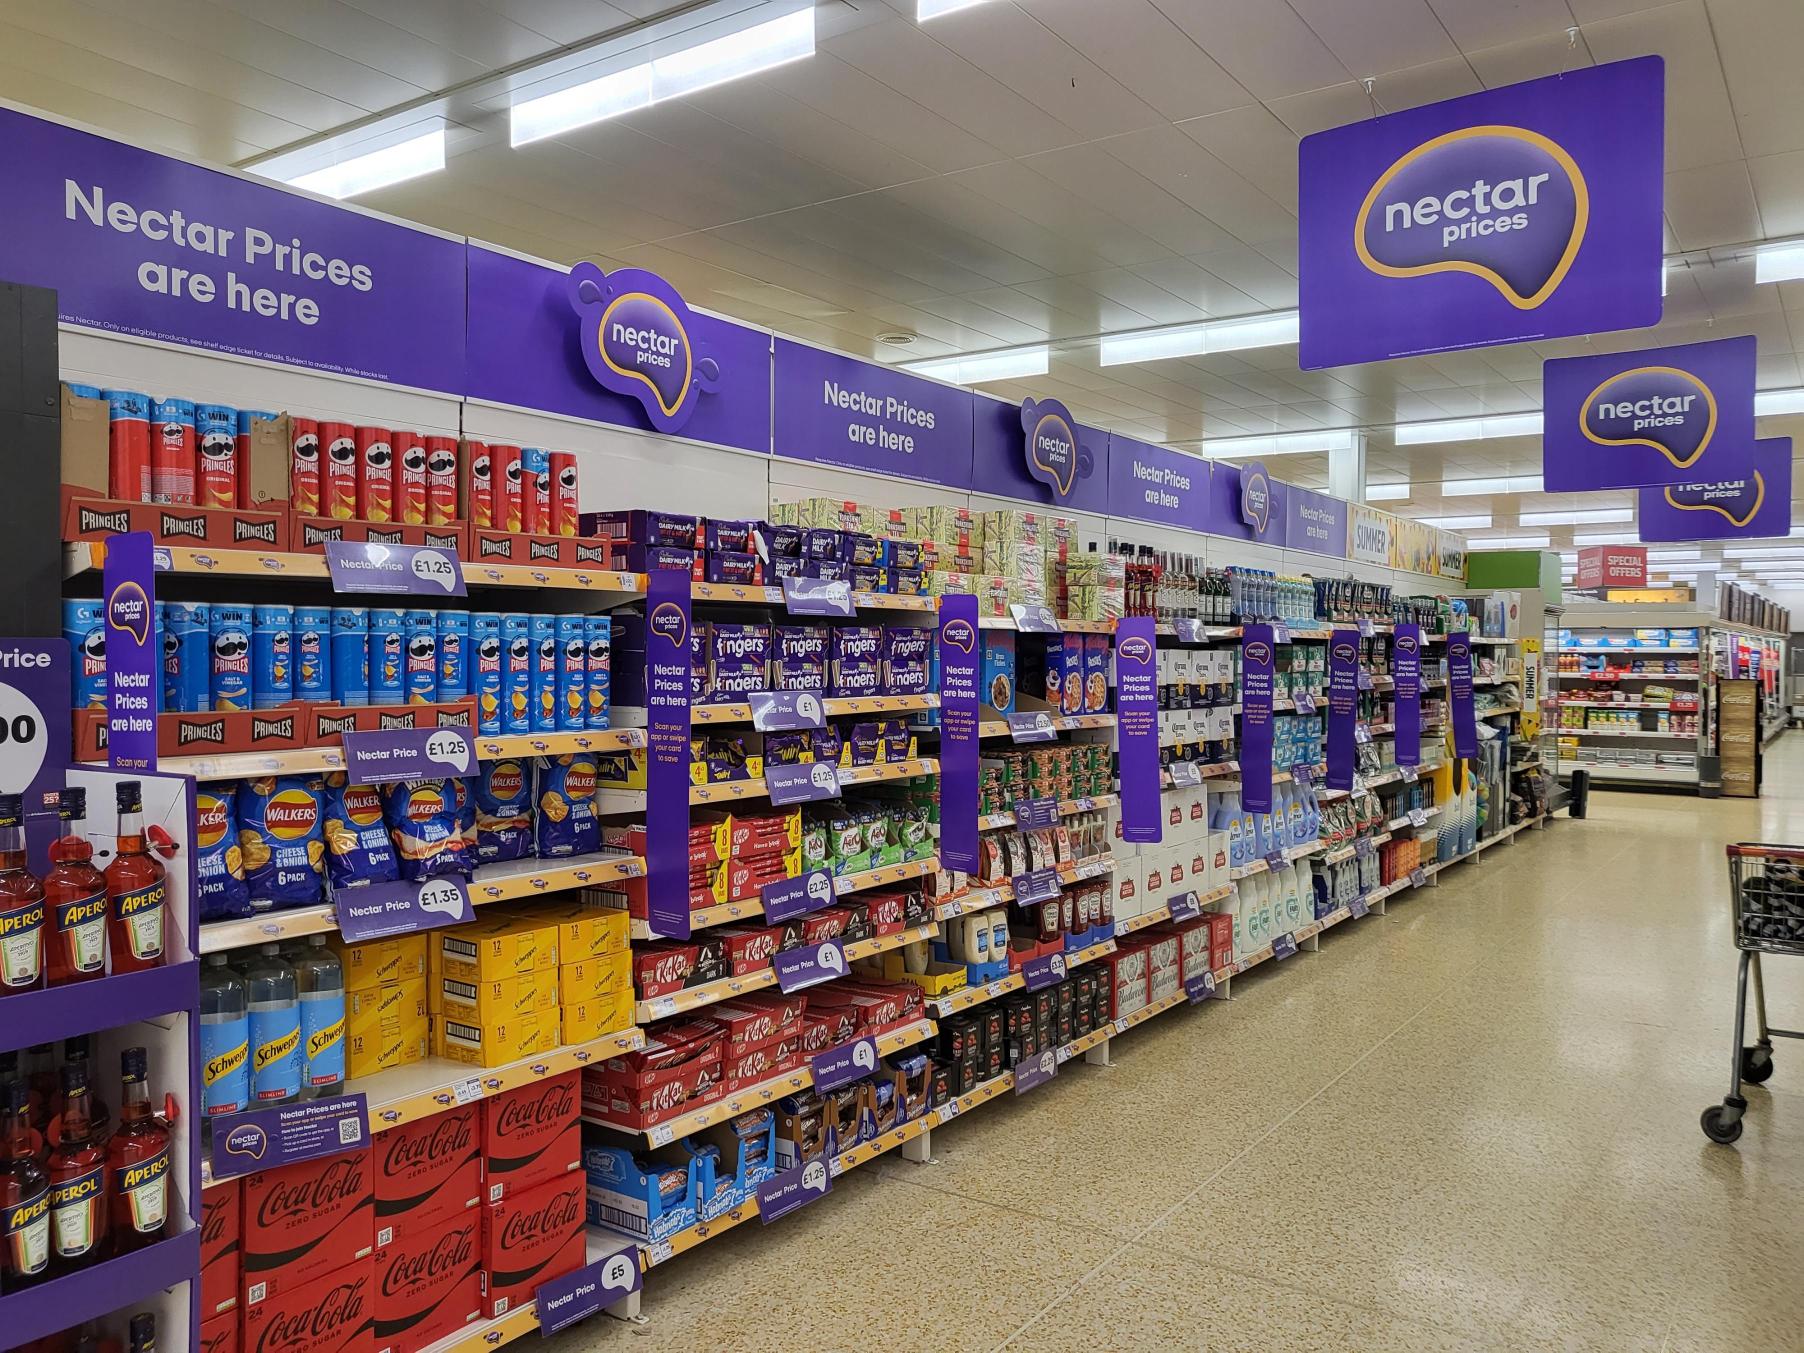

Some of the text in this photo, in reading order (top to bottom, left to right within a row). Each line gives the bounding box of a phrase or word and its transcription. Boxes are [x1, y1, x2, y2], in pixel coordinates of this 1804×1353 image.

[1386, 172, 1549, 233] nectar
[65, 178, 373, 292] Nectar Prices
[1443, 211, 1529, 248] prices
[137, 261, 320, 325] are here
[104, 321, 120, 331] Only
[131, 327, 156, 337] eligible
[286, 356, 307, 365] Subject
[612, 322, 679, 355] nectar
[636, 350, 671, 368] prices
[824, 380, 935, 429] Nectar Prices
[1598, 392, 1696, 420] nectar
[1633, 412, 1684, 431] prices
[848, 422, 914, 453] are here
[1038, 433, 1069, 455] nectar
[201, 458, 235, 475] PRINGLES
[1049, 453, 1065, 464] prices
[1133, 461, 1190, 490] Nectar Prices
[1145, 489, 1179, 509] are here
[1249, 489, 1266, 502] nectar
[1704, 489, 1741, 500] prices
[82, 509, 127, 533] PRINGLES
[1301, 504, 1335, 525] Nectar Prices
[163, 515, 204, 538] PRINGLES
[236, 520, 275, 541] PRINGLES
[1306, 525, 1328, 540] are here
[482, 540, 510, 557] PRINGLES
[1357, 524, 1385, 554] SUMMER
[532, 544, 558, 559] PRINGLES
[578, 547, 602, 562] PRINGLES
[1608, 555, 1644, 567] SPECIAL
[379, 562, 403, 571] Price
[415, 560, 451, 573] £1.25
[1580, 556, 1600, 569] SPECIAL
[1581, 567, 1600, 579] OFFERS
[1609, 567, 1642, 578] OFFERS
[114, 599, 142, 614] nectar
[125, 612, 140, 621] prices
[656, 616, 680, 624] nectar
[717, 638, 763, 657] fingers
[840, 638, 876, 657] fingers
[215, 658, 248, 673] PRINGLES
[655, 664, 685, 675] Nectar
[946, 666, 974, 675] Nectar
[115, 672, 150, 688] Nectar
[655, 680, 683, 690] Prices
[947, 677, 972, 686] Prices
[1525, 666, 1534, 700] SUMMER
[116, 694, 147, 709] Prices
[651, 695, 687, 706] are here
[944, 689, 976, 698] are here
[112, 715, 152, 731] are here
[181, 723, 223, 741] PRINGLES
[255, 720, 292, 737] PRINGLES
[357, 741, 465, 760] Nectar Price £1.25
[116, 757, 148, 769] Scan your
[774, 780, 792, 788] Nectar
[813, 772, 832, 782] £1.25
[267, 808, 316, 821] WALKERS
[794, 820, 799, 834] 8
[722, 829, 727, 846] 8
[808, 839, 823, 854] Aero
[770, 880, 829, 905] Nectar Price £2.25
[350, 889, 459, 917] Nectar Price £1.35
[352, 950, 363, 961] 12
[514, 946, 538, 968] Schweppes
[745, 936, 773, 961] KitKat
[376, 956, 403, 978] Schweppes
[656, 955, 686, 983] KitKat
[782, 952, 834, 974] Nectar Price £1
[1028, 960, 1063, 978] Nectar Price £3.25
[1152, 971, 1177, 989] Budweiser
[1118, 985, 1146, 1002] Budweiser
[745, 1017, 771, 1041] KitKat
[804, 1024, 828, 1050] KitKat
[353, 1036, 363, 1048] 12
[378, 1039, 404, 1064] Schweppes
[818, 1050, 867, 1076] Nectar Price £1
[281, 1110, 305, 1119] Nectar
[307, 1106, 328, 1115] Prices
[342, 1100, 356, 1108] here
[497, 1081, 576, 1137] Coca-Cola
[231, 1133, 260, 1145] nectar
[384, 1111, 473, 1177] Coca-Cola
[125, 1153, 169, 1187] APEROL
[257, 1152, 368, 1229] Coca-Cola
[764, 1167, 825, 1203] Nectar Price £1.25
[501, 1187, 581, 1251] Coca-Cola
[654, 1217, 680, 1236] Hobnobs
[382, 1223, 475, 1297] Coca-Cola
[548, 1263, 625, 1311] Nectar Price £5
